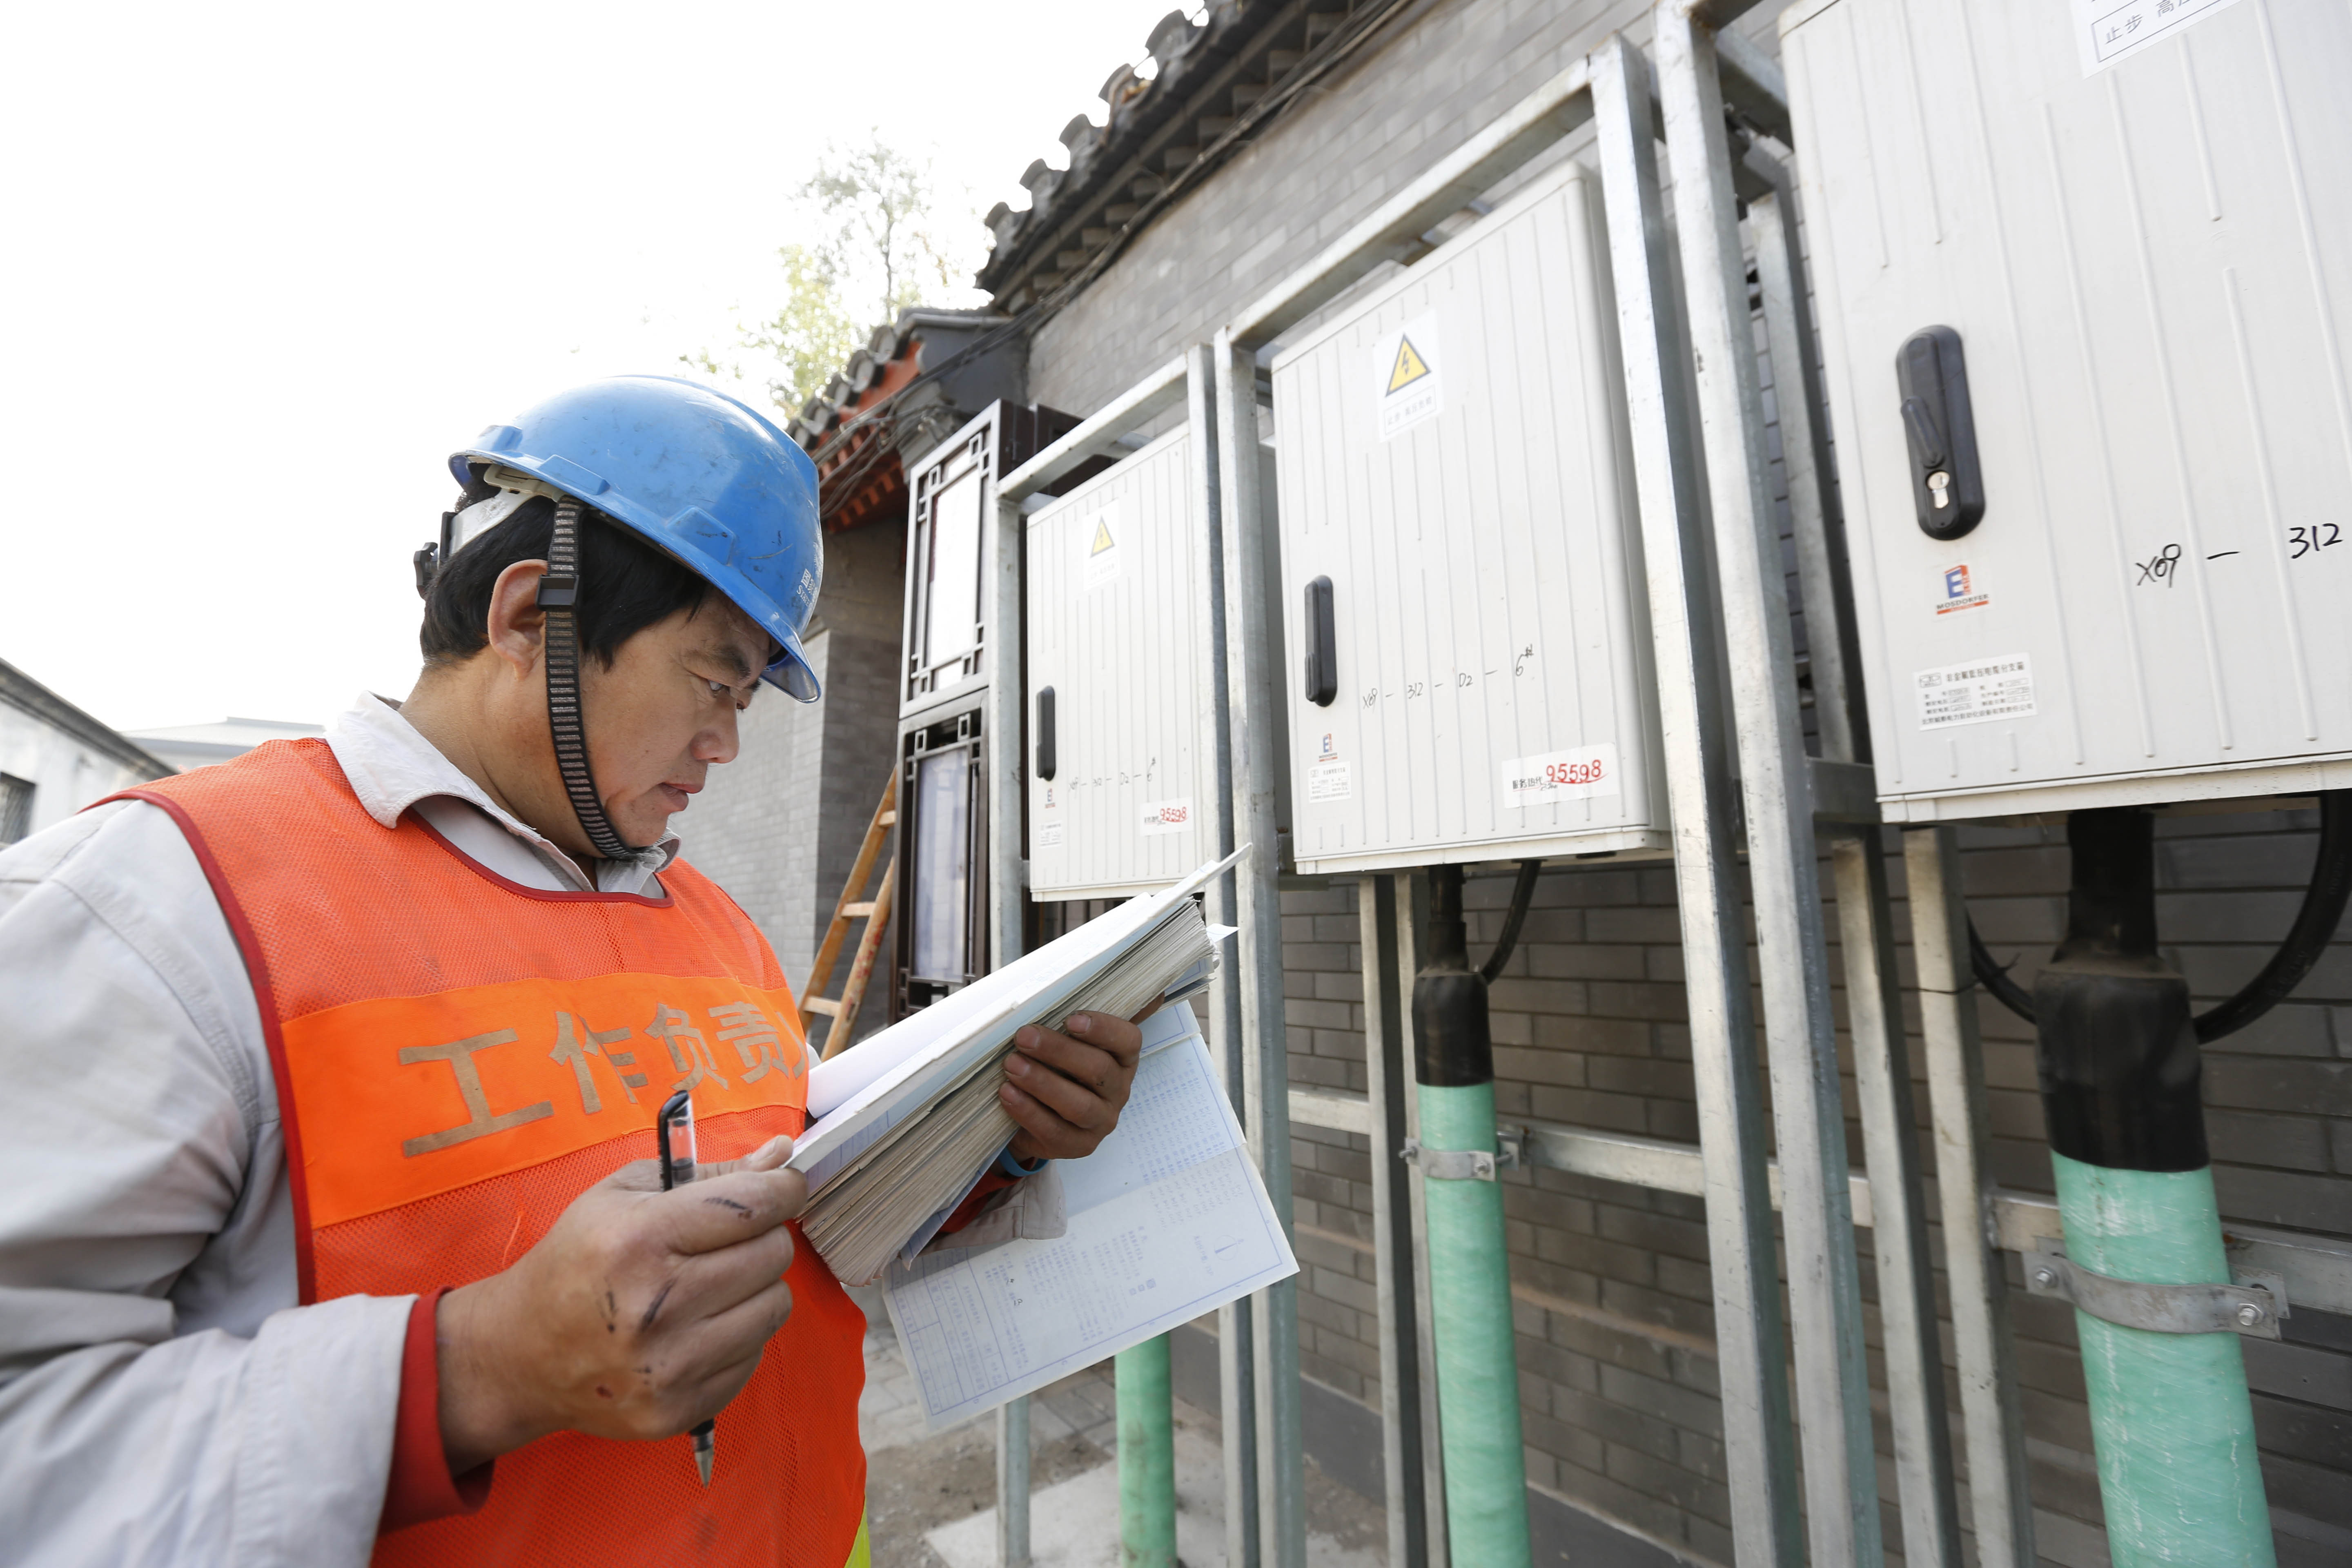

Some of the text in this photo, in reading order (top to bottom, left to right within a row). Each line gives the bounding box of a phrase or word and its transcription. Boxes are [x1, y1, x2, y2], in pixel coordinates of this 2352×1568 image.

[2105, 13, 2143, 45] 止步
[2289, 523, 2343, 559] 312
[1936, 594, 1989, 610] MOSDORFER
[1407, 682, 1424, 699] 312
[1546, 759, 1602, 783] 95598
[1160, 806, 1187, 821] 95598
